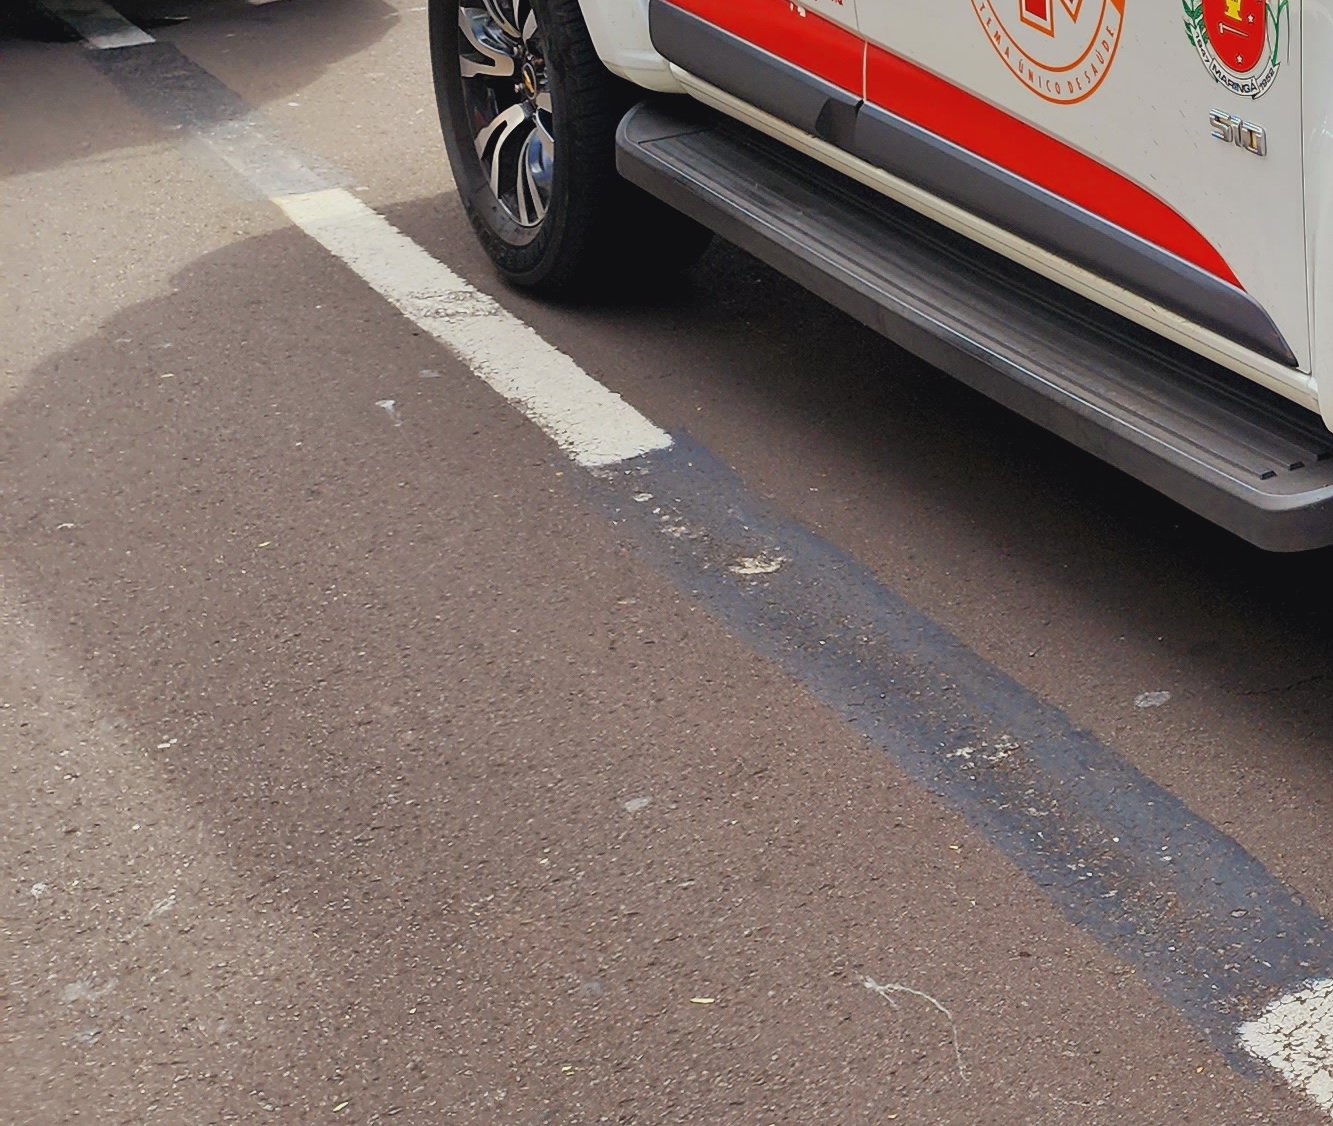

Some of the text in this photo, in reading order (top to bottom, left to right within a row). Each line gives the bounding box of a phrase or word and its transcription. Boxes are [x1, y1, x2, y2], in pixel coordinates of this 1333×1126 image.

[1018, 58, 1062, 95] ÚNICO
[1067, 76, 1083, 94] DE
[1084, 25, 1117, 85] SAÚDE
[1209, 107, 1268, 157] S10
